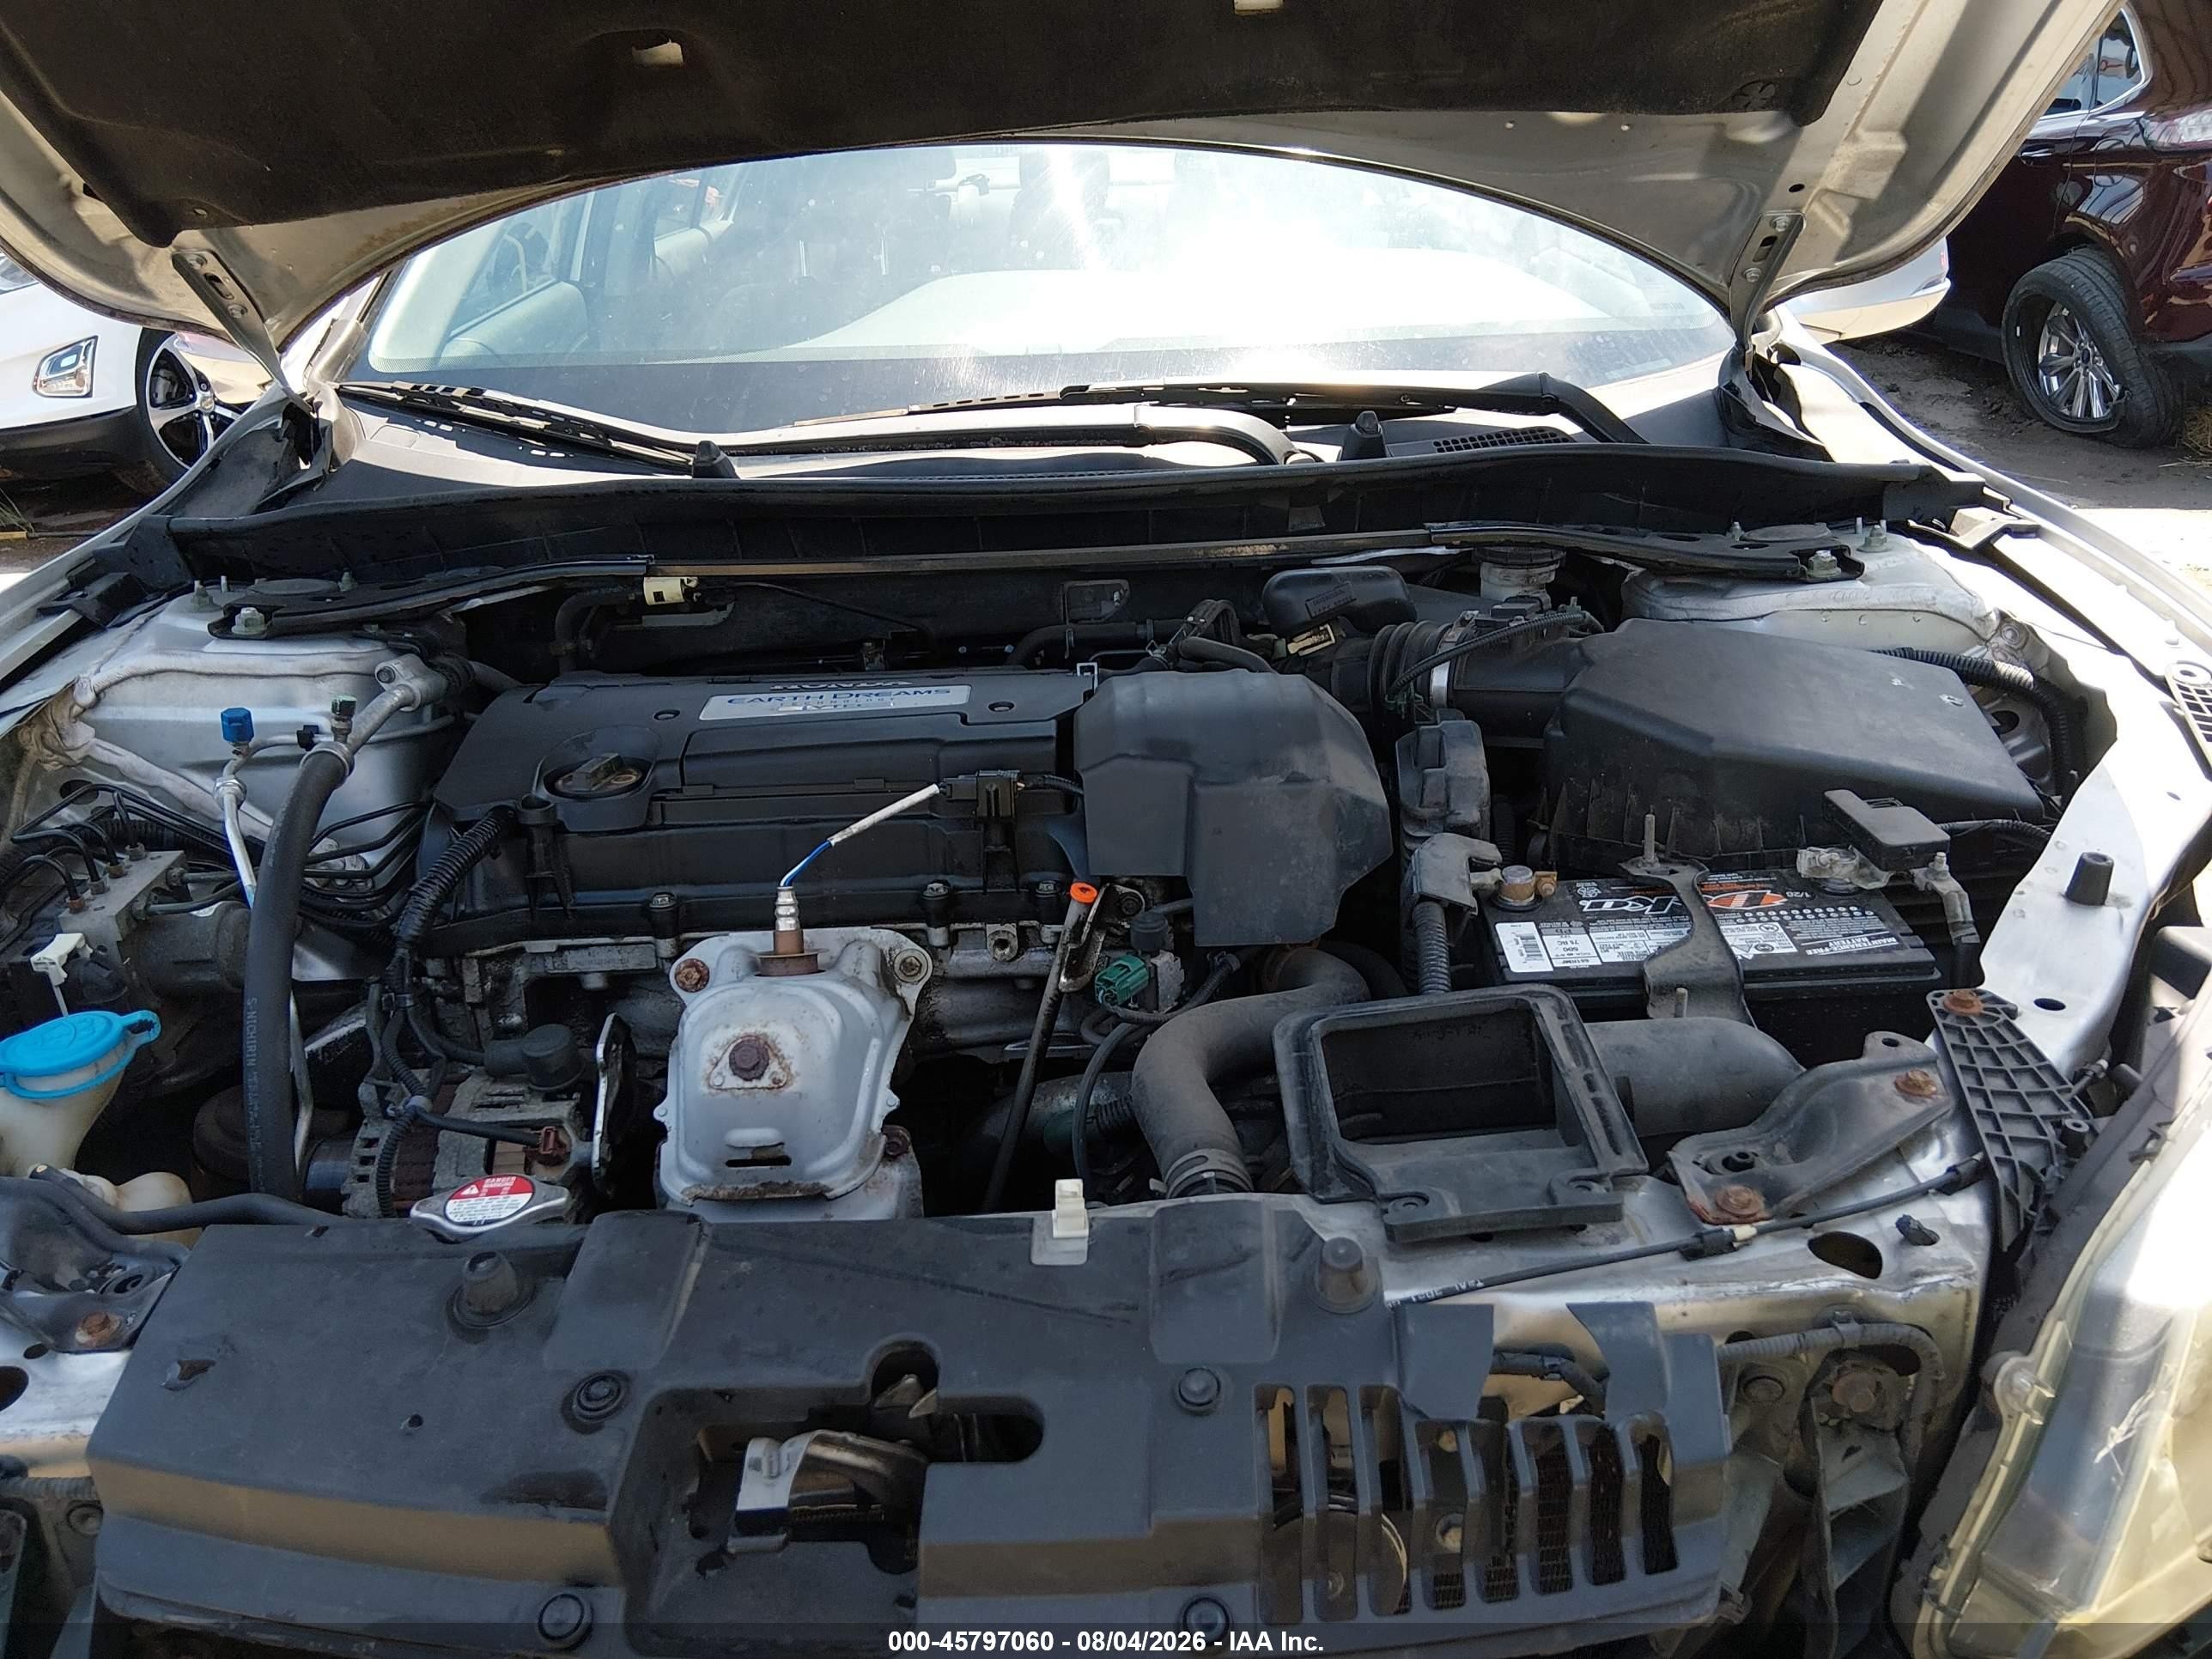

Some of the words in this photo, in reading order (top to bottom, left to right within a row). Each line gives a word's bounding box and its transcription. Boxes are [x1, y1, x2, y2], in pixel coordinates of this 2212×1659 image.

[727, 691, 825, 705] EARTH
[832, 687, 951, 700] DREAMS
[1786, 890, 1811, 899] 1/20
[1805, 938, 1897, 956] MAINTENANCE-FREE
[1828, 937, 1871, 948] BATTERY
[246, 996, 258, 1067] S-NICHIRIN
